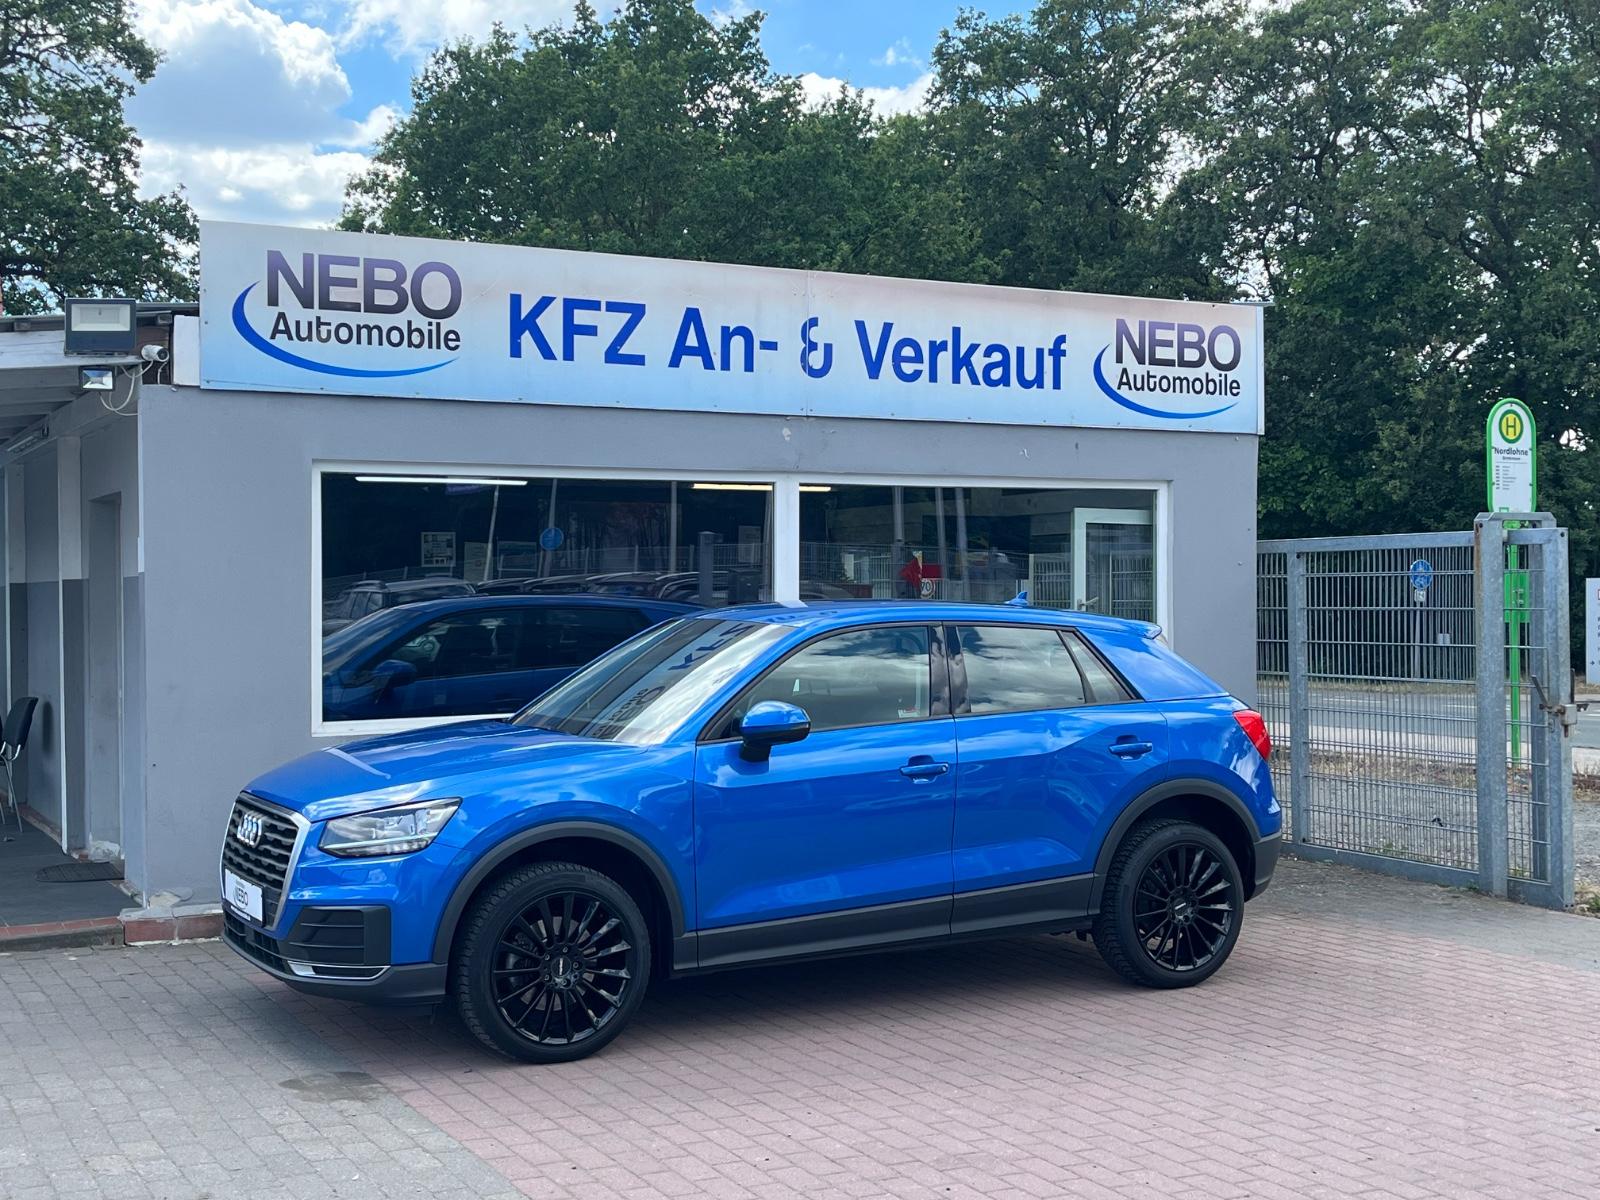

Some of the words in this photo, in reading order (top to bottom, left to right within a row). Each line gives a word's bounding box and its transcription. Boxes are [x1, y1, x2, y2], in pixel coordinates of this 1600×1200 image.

[267, 250, 462, 319] NEBO
[270, 312, 461, 351] Automobile
[510, 294, 646, 366] KFZ
[668, 307, 778, 372] An-
[800, 316, 832, 378] &
[855, 320, 1067, 390] Verkauf
[1116, 319, 1241, 371] NEBO
[1117, 367, 1240, 397] Automobile
[1506, 417, 1516, 436] H
[1494, 447, 1529, 456] Nordlohne
